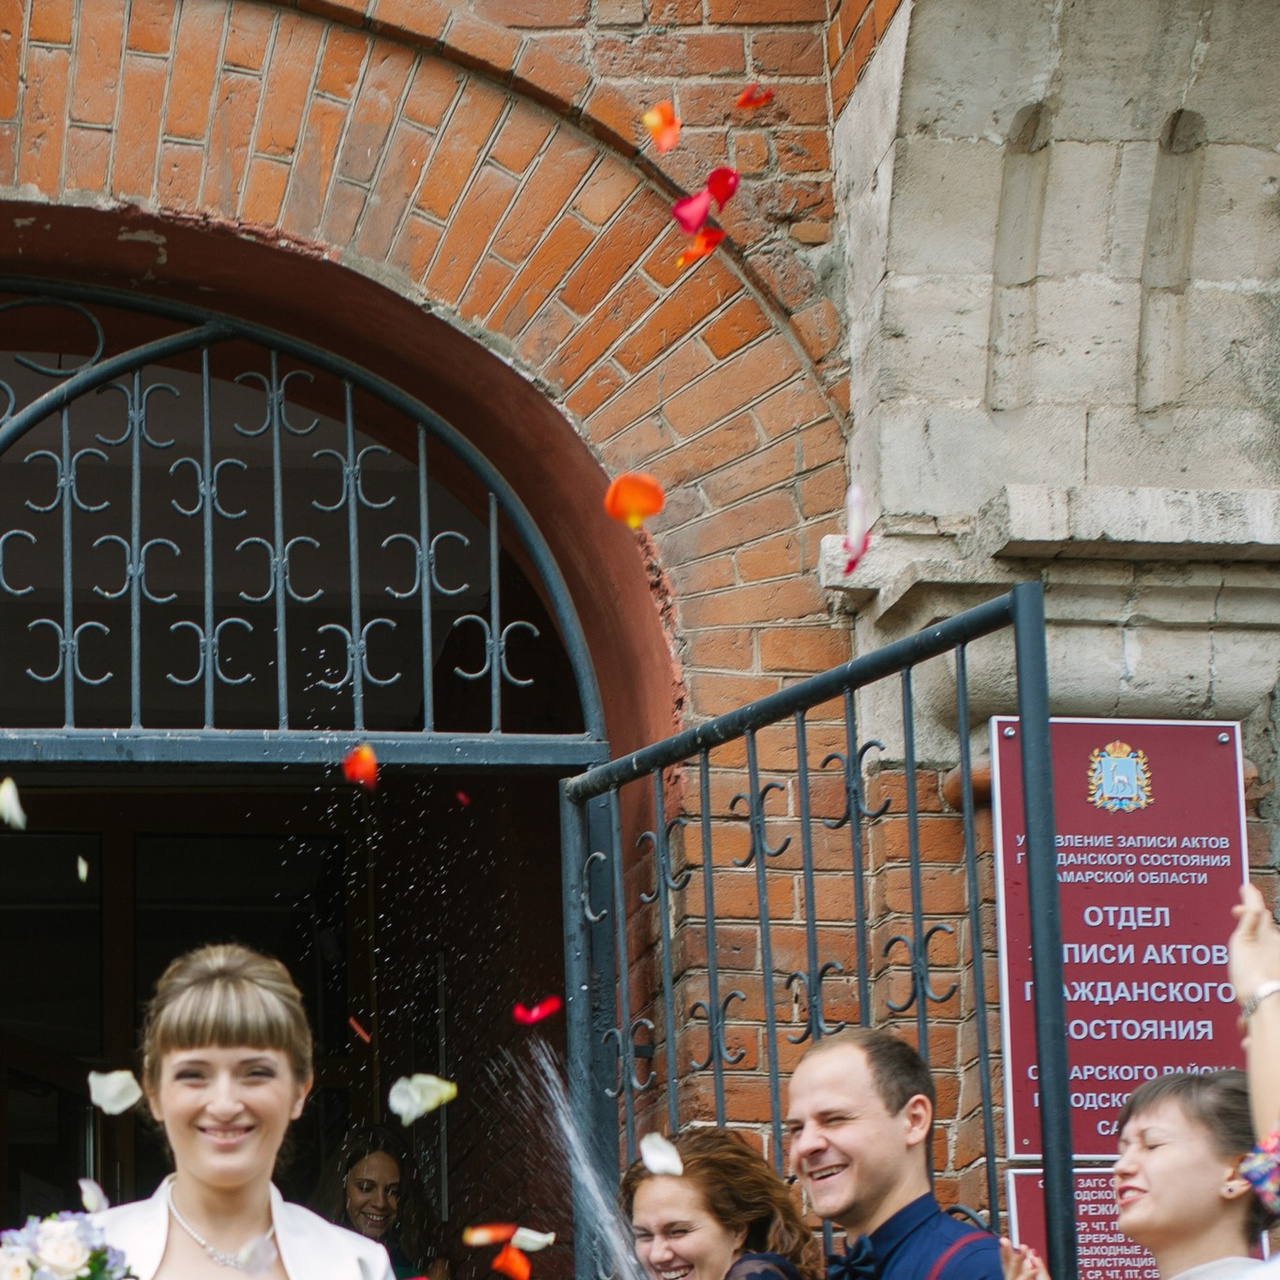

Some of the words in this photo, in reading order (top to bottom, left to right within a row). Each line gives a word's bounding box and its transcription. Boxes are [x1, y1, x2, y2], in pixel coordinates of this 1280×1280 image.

[1016, 834, 1114, 847] УВЛЕНИЕ
[1117, 836, 1177, 848] ЗАПИСИ
[1180, 837, 1230, 849] АКТОВ
[1016, 852, 1136, 867] ГДАНСКОГО
[1139, 854, 1231, 867] СОСТОЯНИЯ
[1138, 872, 1208, 885] ОБЛАСТИ
[1084, 906, 1170, 930] ОТДЕЛ
[1027, 943, 1135, 964] ПИСИ
[1142, 944, 1229, 965] АКТОВ
[1065, 1019, 1214, 1041] ОСТОЯНИЯ
[1027, 1065, 1158, 1081] САРСКОГО
[1078, 1178, 1107, 1188] ЗАГС
[1078, 1203, 1119, 1216] РЕЖИ
[1077, 1234, 1125, 1244] ЕРЕРЫВ
[1086, 1270, 1104, 1280] СР,
[1106, 1270, 1123, 1280] ЧТ,
